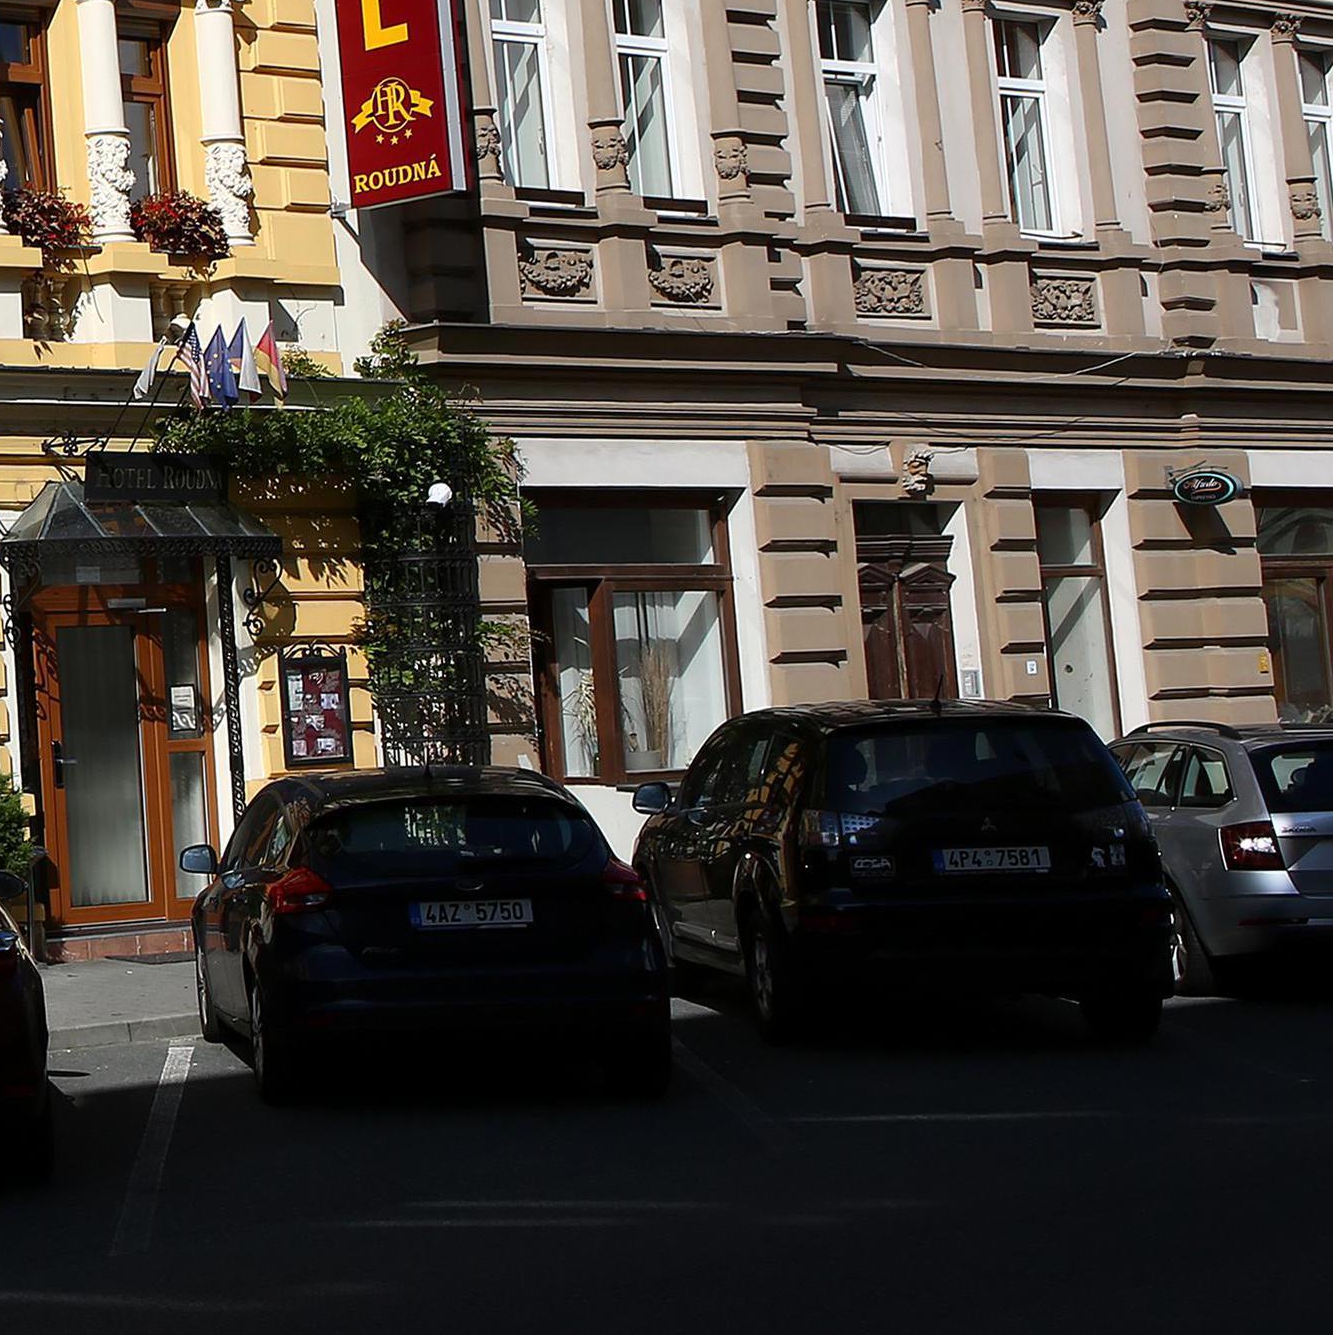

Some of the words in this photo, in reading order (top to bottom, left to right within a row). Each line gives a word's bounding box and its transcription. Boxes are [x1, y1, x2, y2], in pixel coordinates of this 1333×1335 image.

[354, 154, 442, 194] ROUDNÁ
[949, 850, 982, 868] 4P4
[995, 849, 1041, 866] 7581
[425, 904, 462, 923] 4AZ
[476, 901, 524, 922] 5750
